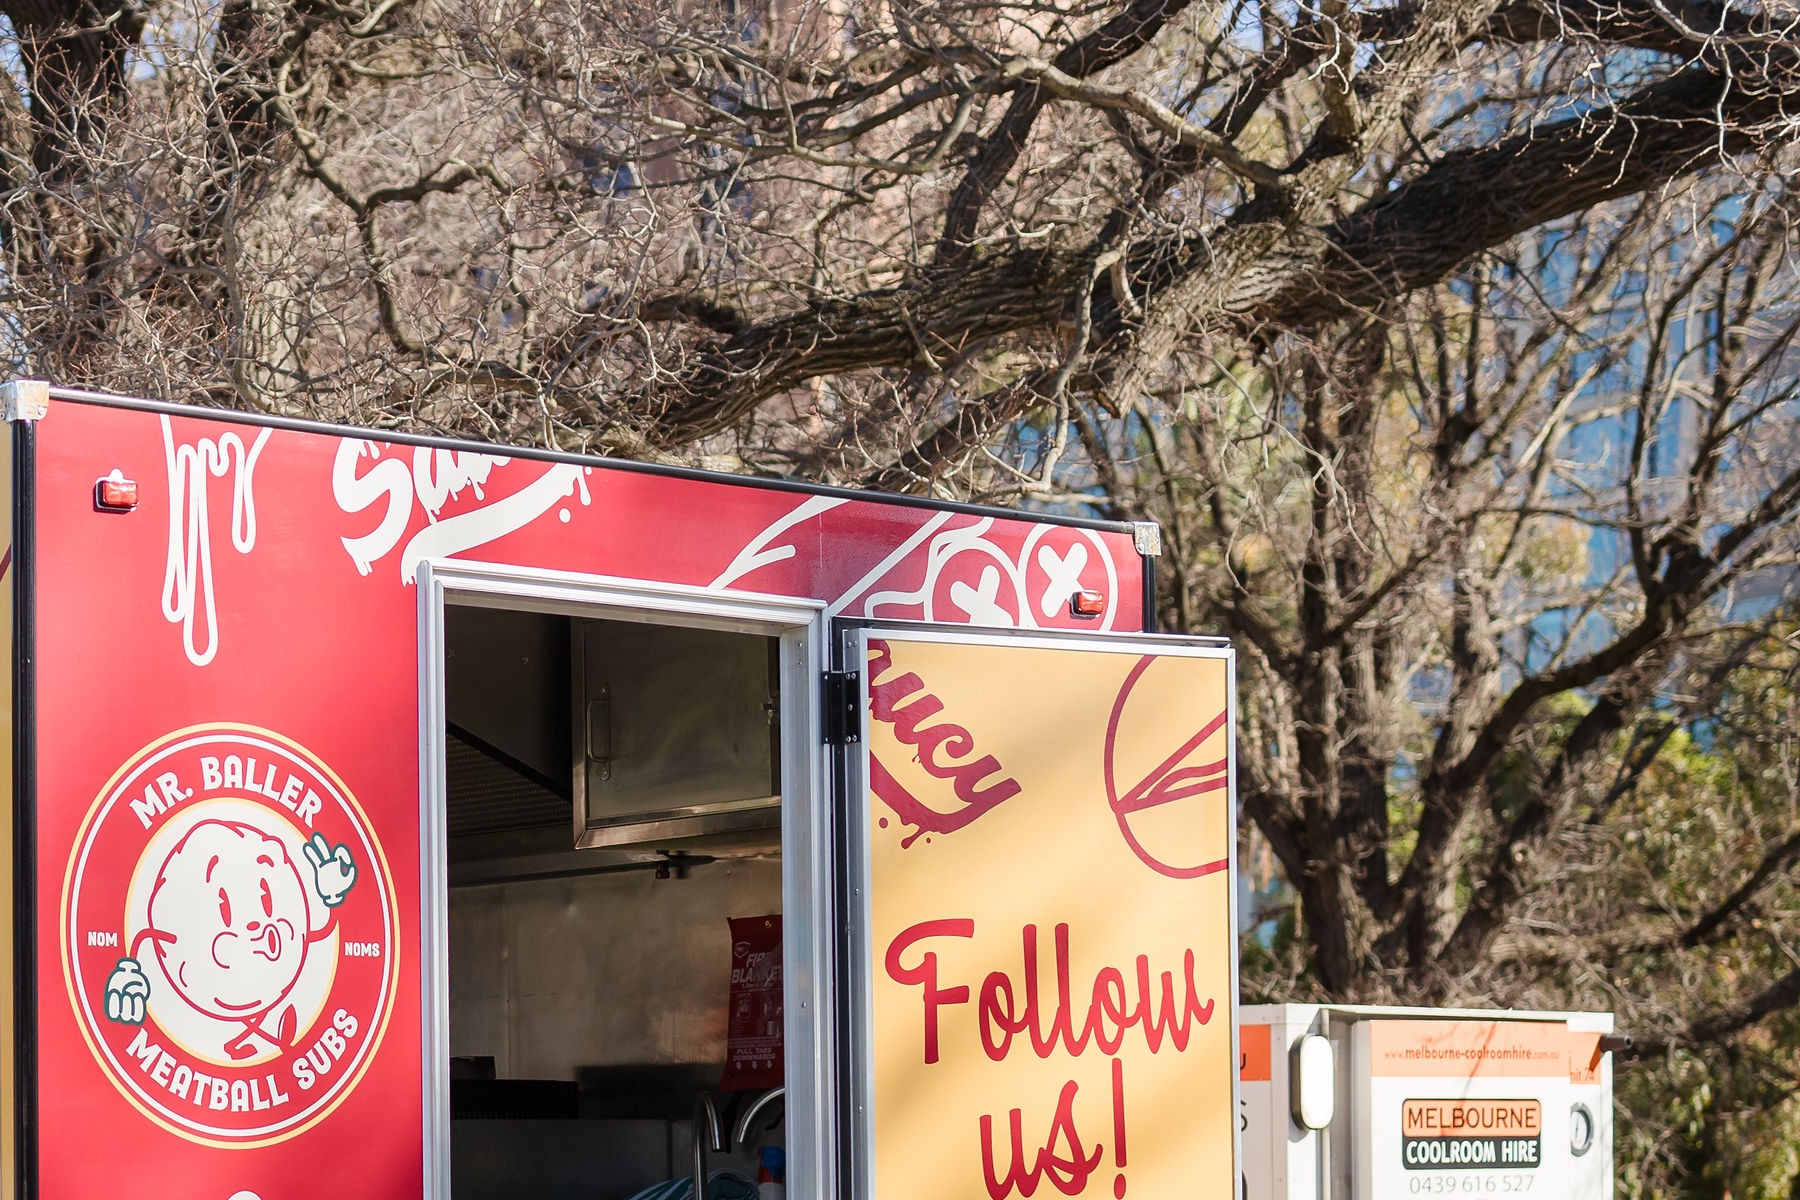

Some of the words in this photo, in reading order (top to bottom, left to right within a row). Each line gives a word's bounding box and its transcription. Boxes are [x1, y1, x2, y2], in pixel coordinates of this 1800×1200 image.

[129, 771, 193, 830] MR.
[200, 754, 323, 828] BALLER
[88, 931, 118, 947] NOM
[344, 941, 380, 957] NOMS
[884, 918, 1215, 1064] Follow
[125, 1027, 289, 1112] MEATBALL
[292, 1008, 359, 1090] SUBS
[1407, 1107, 1537, 1129] MELBOURNE
[1406, 1140, 1496, 1165] COOLROOM
[1501, 1139, 1538, 1164] HIRE
[1409, 1175, 1457, 1194] 0439
[1462, 1175, 1497, 1193] 616
[1501, 1174, 1535, 1192] 527
